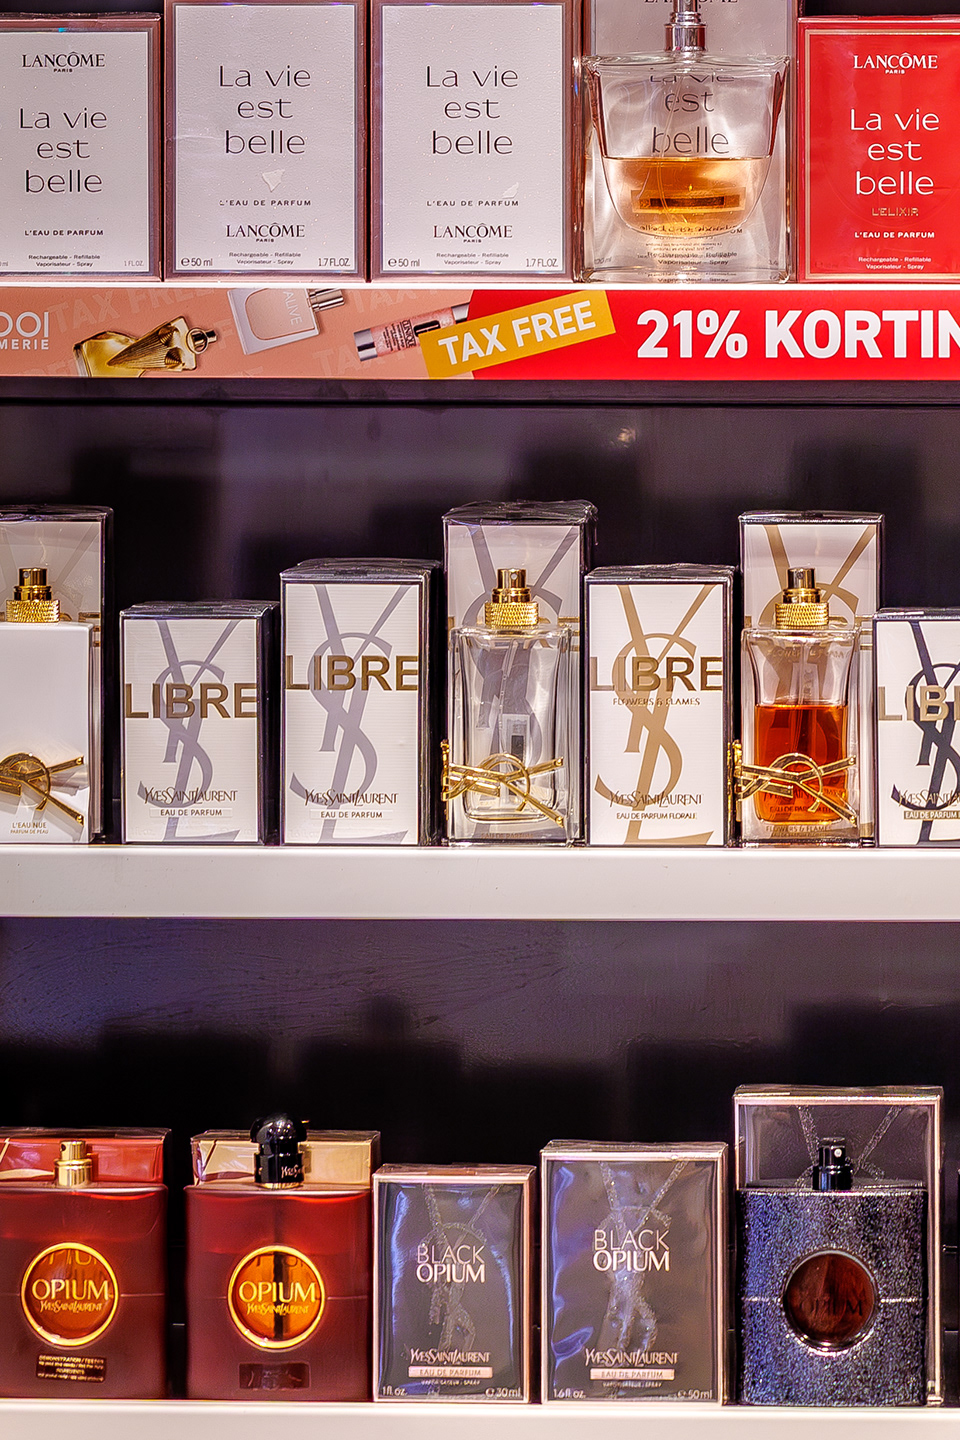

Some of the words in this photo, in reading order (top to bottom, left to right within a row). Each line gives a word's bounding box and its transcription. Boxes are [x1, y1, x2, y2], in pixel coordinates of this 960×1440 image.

[22, 52, 105, 68] LANCÔME
[853, 53, 938, 69] LANCÔME
[219, 65, 252, 87] La
[265, 64, 311, 87] vie
[426, 66, 459, 88] La
[471, 65, 519, 88] vie
[20, 108, 50, 129] La
[63, 107, 107, 129] vie
[236, 98, 294, 120] est
[444, 98, 501, 119] est
[850, 109, 883, 132] La
[894, 108, 940, 132] vie
[37, 139, 90, 159] est
[225, 130, 306, 154] belle
[432, 130, 514, 155] belle
[867, 140, 922, 162] est
[26, 170, 103, 193] belle
[856, 171, 934, 196] belle
[438, 328, 507, 366] TAX
[514, 300, 598, 348] FREE
[637, 309, 747, 359] 21%
[285, 655, 419, 691] LIBRE
[590, 656, 722, 691] LIBRE
[124, 683, 257, 719] LIBRE
[594, 1230, 670, 1251] BLACK
[417, 1245, 484, 1263] BLACK
[593, 1250, 670, 1272] OPIUM
[416, 1264, 485, 1283] OPIUM
[32, 1279, 109, 1301] OPIUM
[239, 1281, 316, 1303] OPIUM
